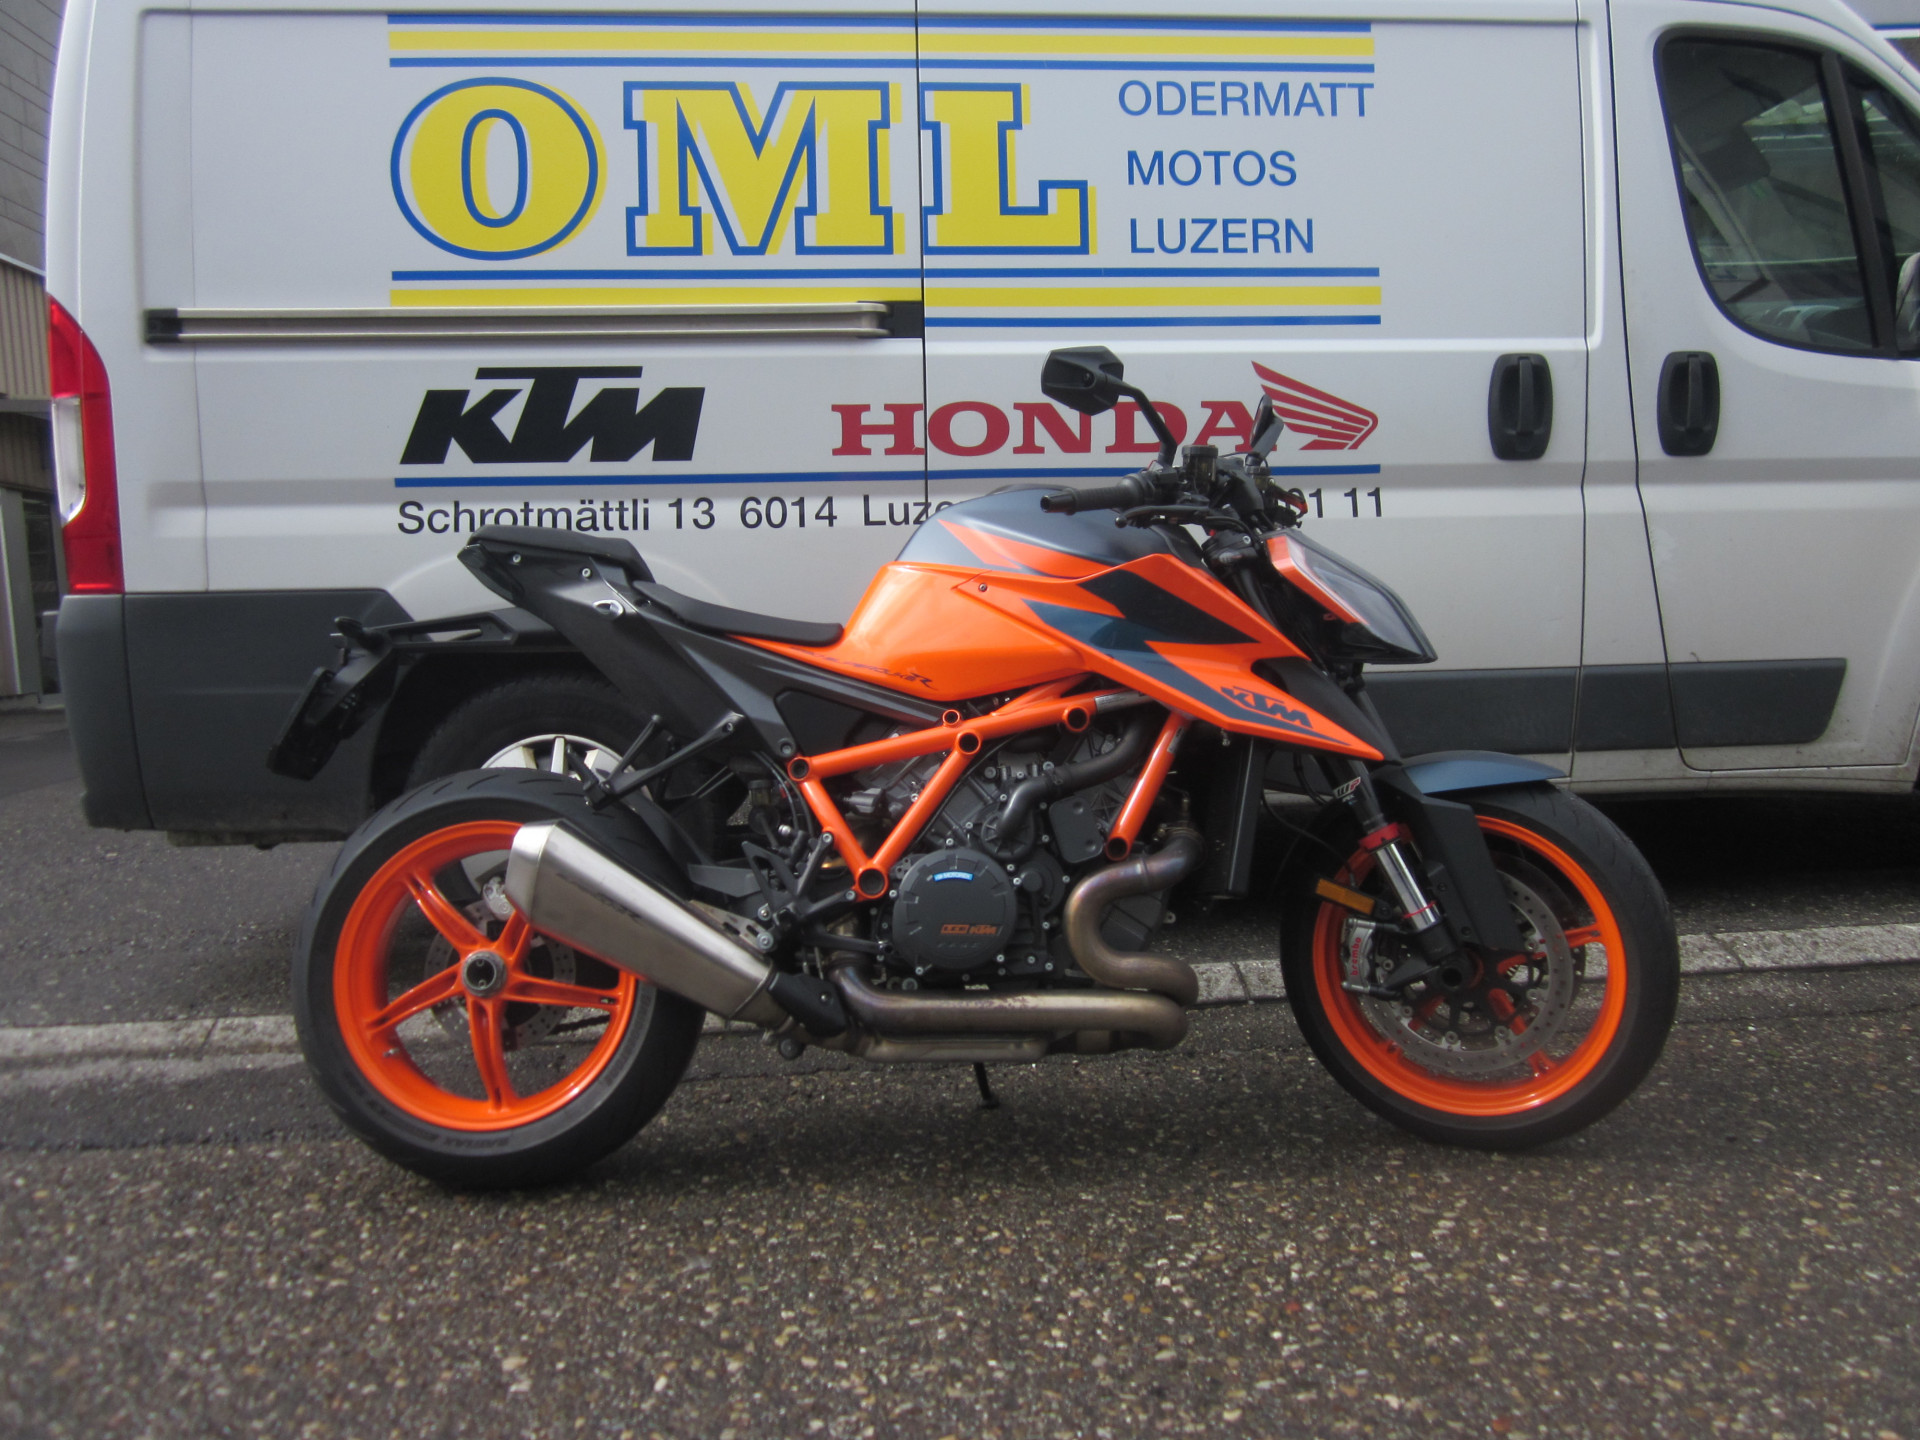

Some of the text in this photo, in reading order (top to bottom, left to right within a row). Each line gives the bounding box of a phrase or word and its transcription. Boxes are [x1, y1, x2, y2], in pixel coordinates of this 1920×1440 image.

[1118, 80, 1374, 117] ODERMATT
[390, 76, 1097, 260] OML
[1127, 150, 1297, 186] MOTOS
[1130, 218, 1314, 254] LUZERN
[400, 366, 705, 464] KTM
[831, 401, 1277, 456] HONDA
[398, 499, 649, 534] Schrotmättli
[668, 497, 715, 529] 13
[740, 496, 837, 528] 6014
[863, 494, 954, 526] Luz
[1221, 686, 1313, 729] KTM
